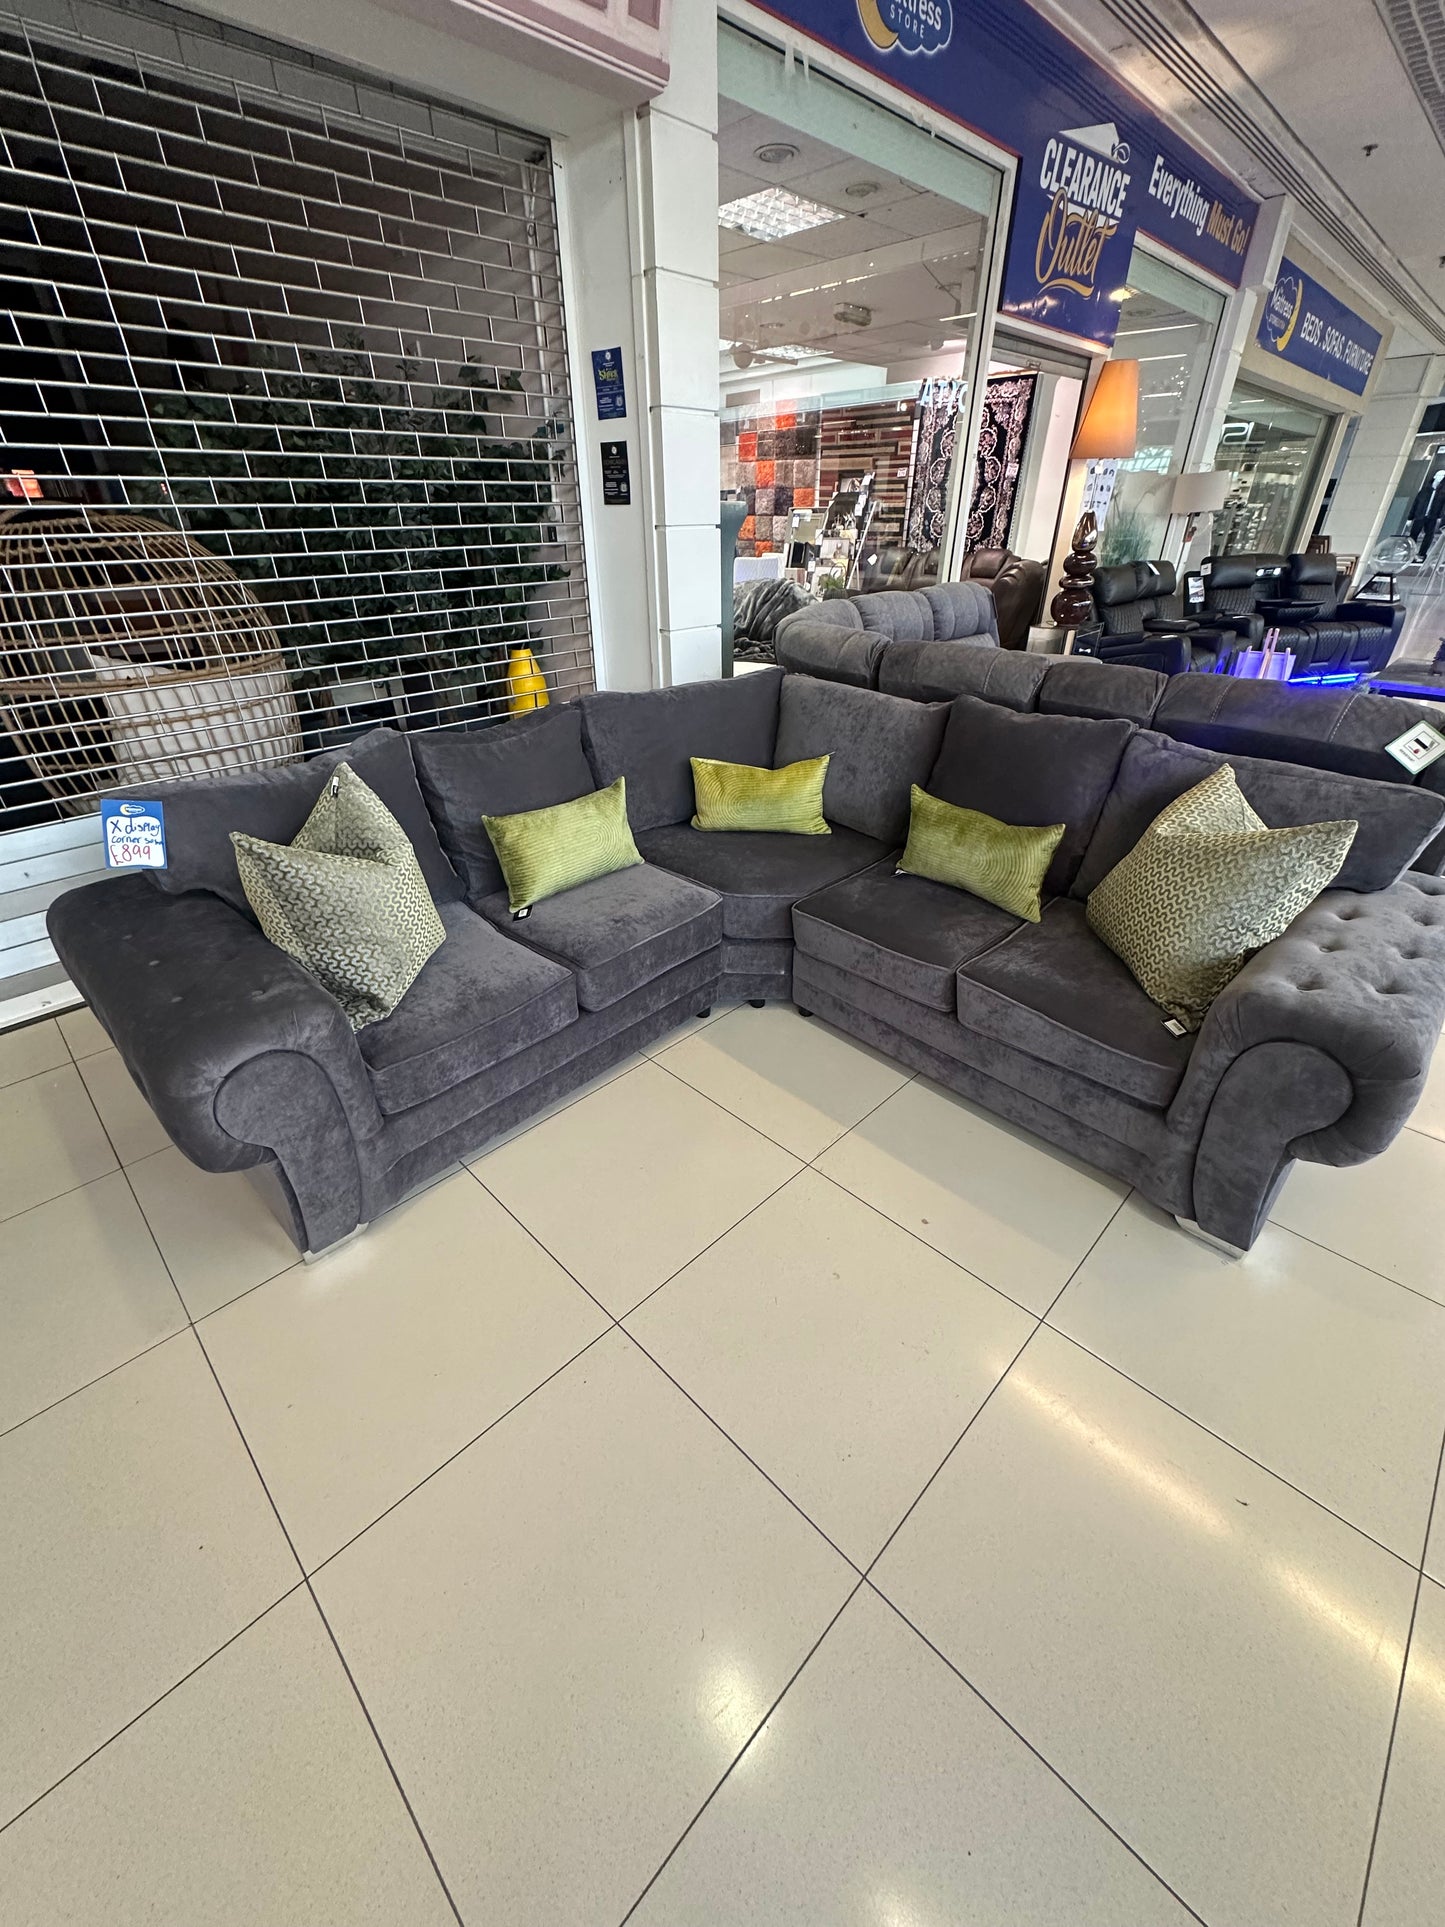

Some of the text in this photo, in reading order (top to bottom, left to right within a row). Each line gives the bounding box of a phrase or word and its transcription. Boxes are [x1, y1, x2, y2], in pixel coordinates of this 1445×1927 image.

[890, 4, 925, 39] STORE
[1040, 138, 1131, 218] CLEARANCE
[1148, 153, 1251, 256] Everything Must Go!
[1035, 187, 1117, 284] Outlet
[110, 843, 151, 866] £899
